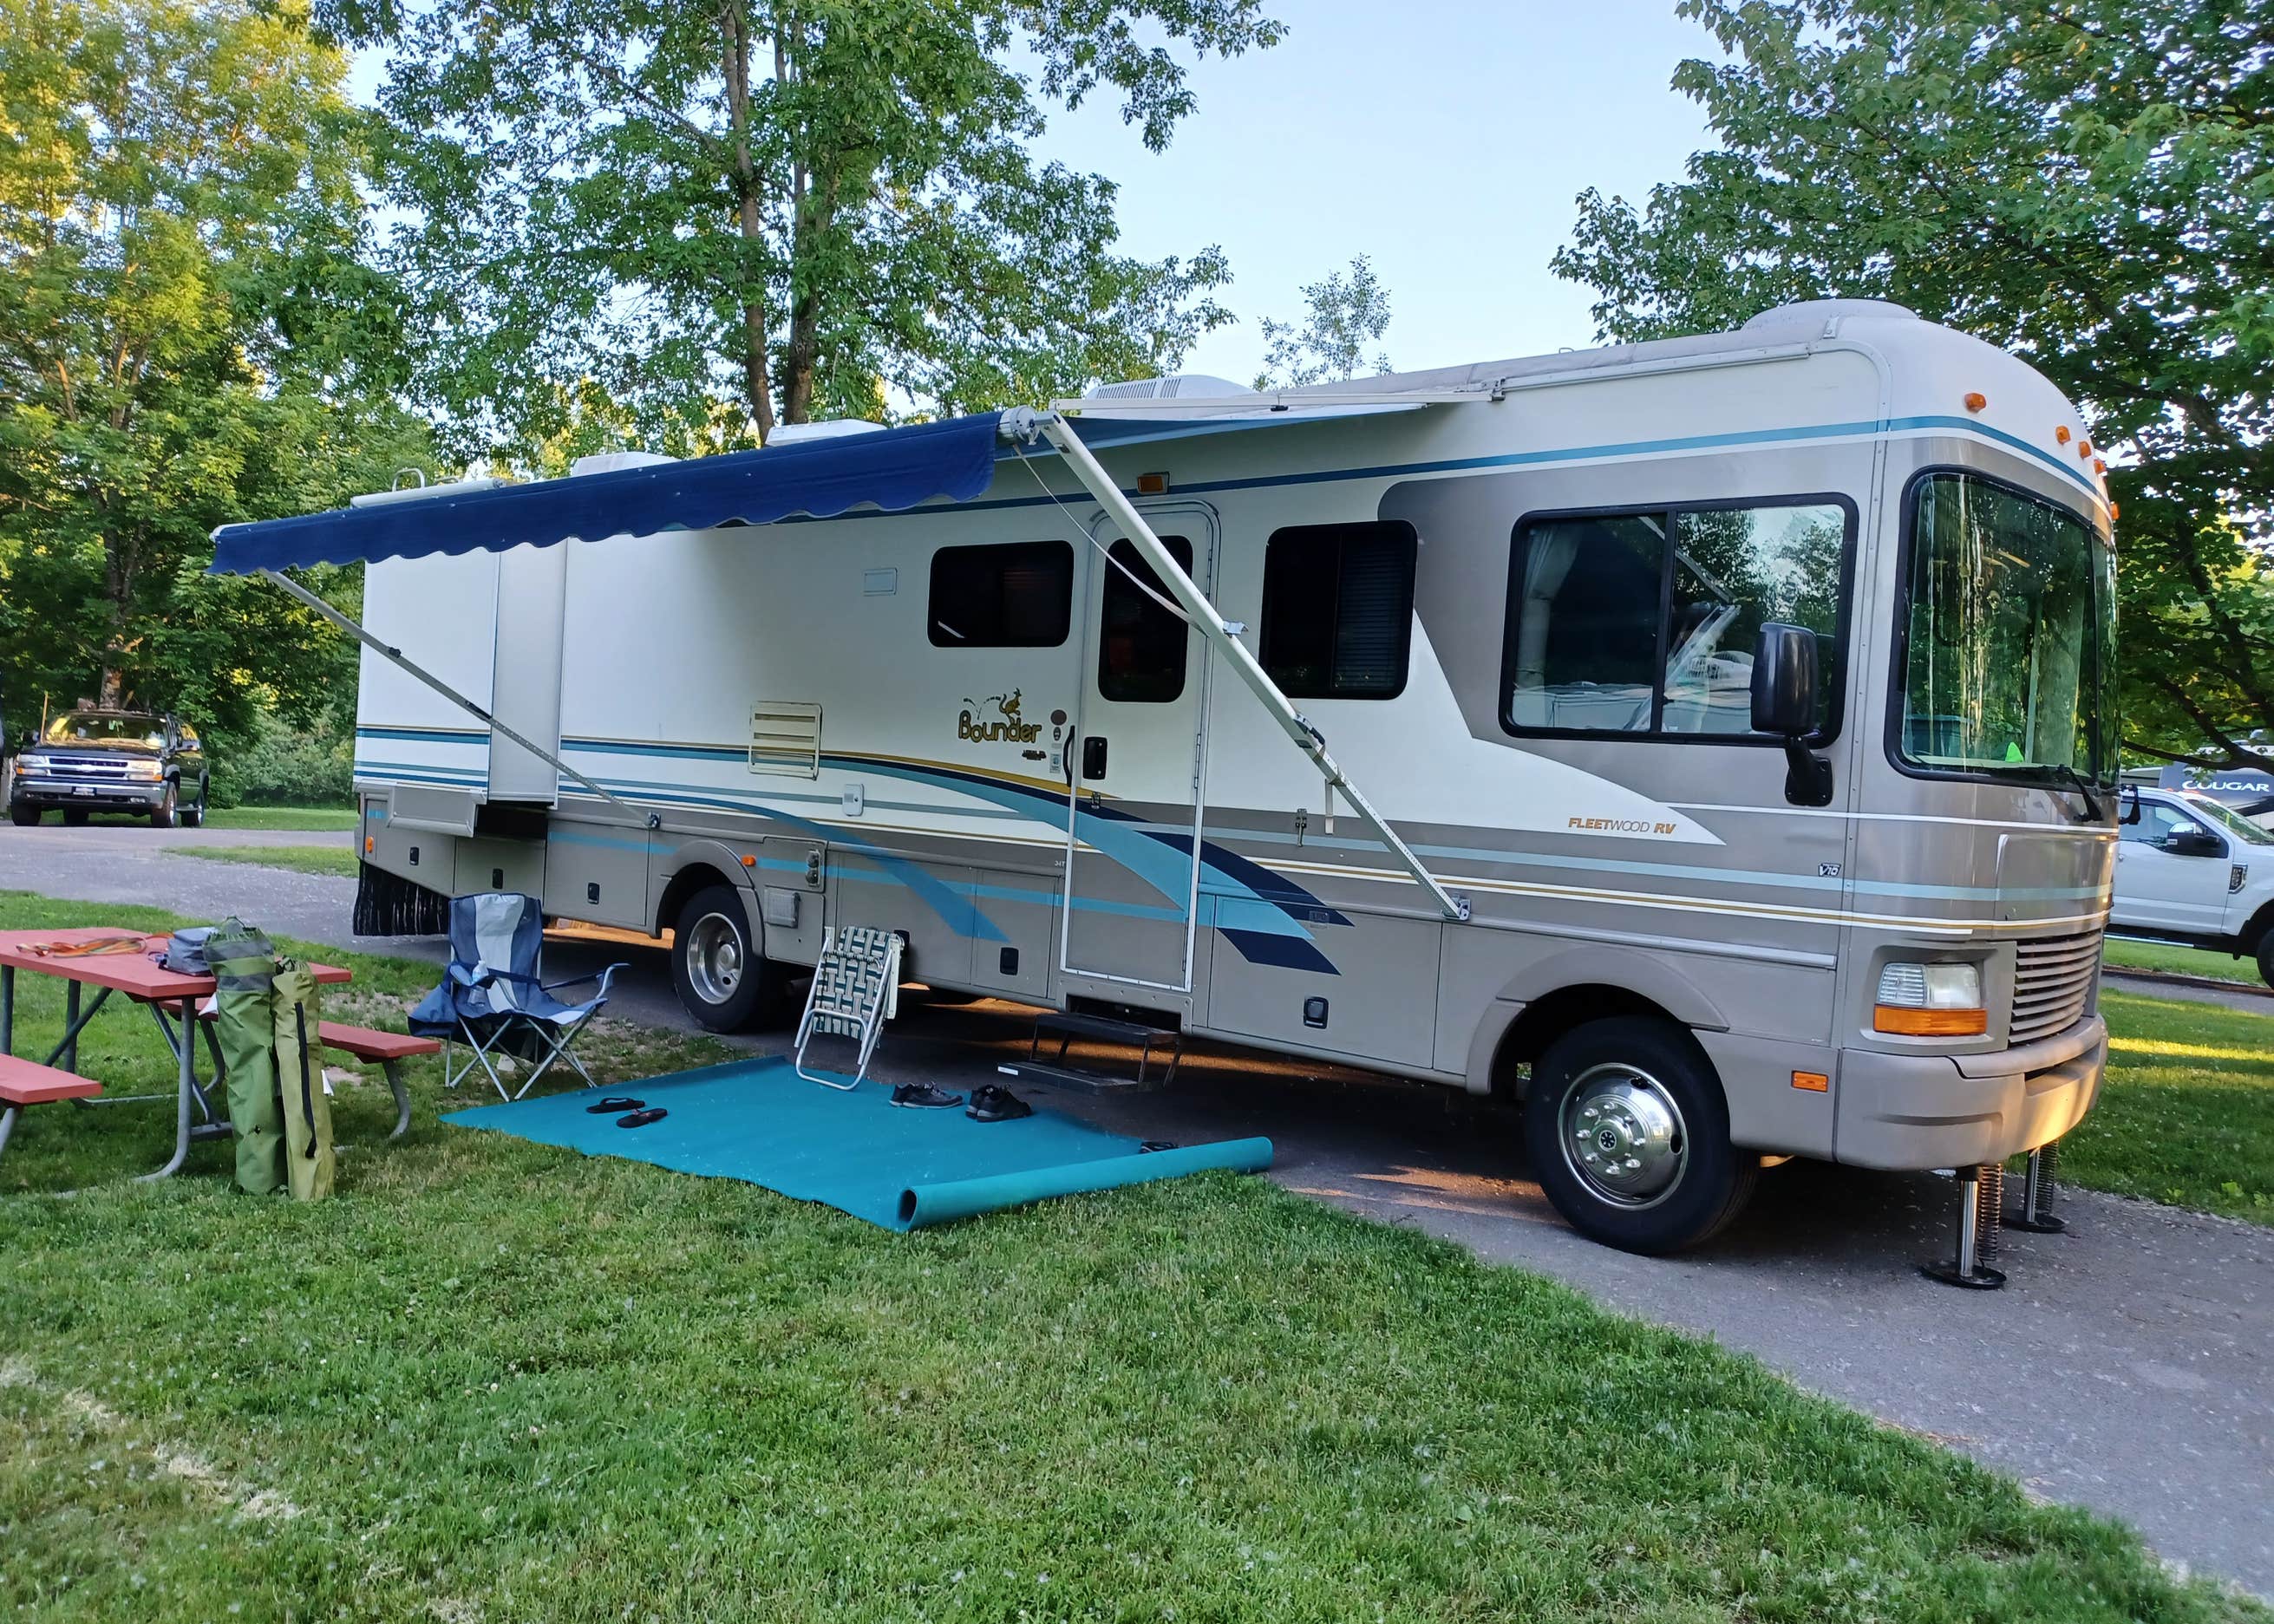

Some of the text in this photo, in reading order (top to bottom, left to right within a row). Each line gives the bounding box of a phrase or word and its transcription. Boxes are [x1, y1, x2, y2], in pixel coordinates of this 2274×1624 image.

[958, 710, 1042, 743] Bounder
[2182, 780, 2270, 792] COUGAR
[1568, 818, 1676, 834] FLEETWOOD RV
[1819, 865, 1839, 876] V10
